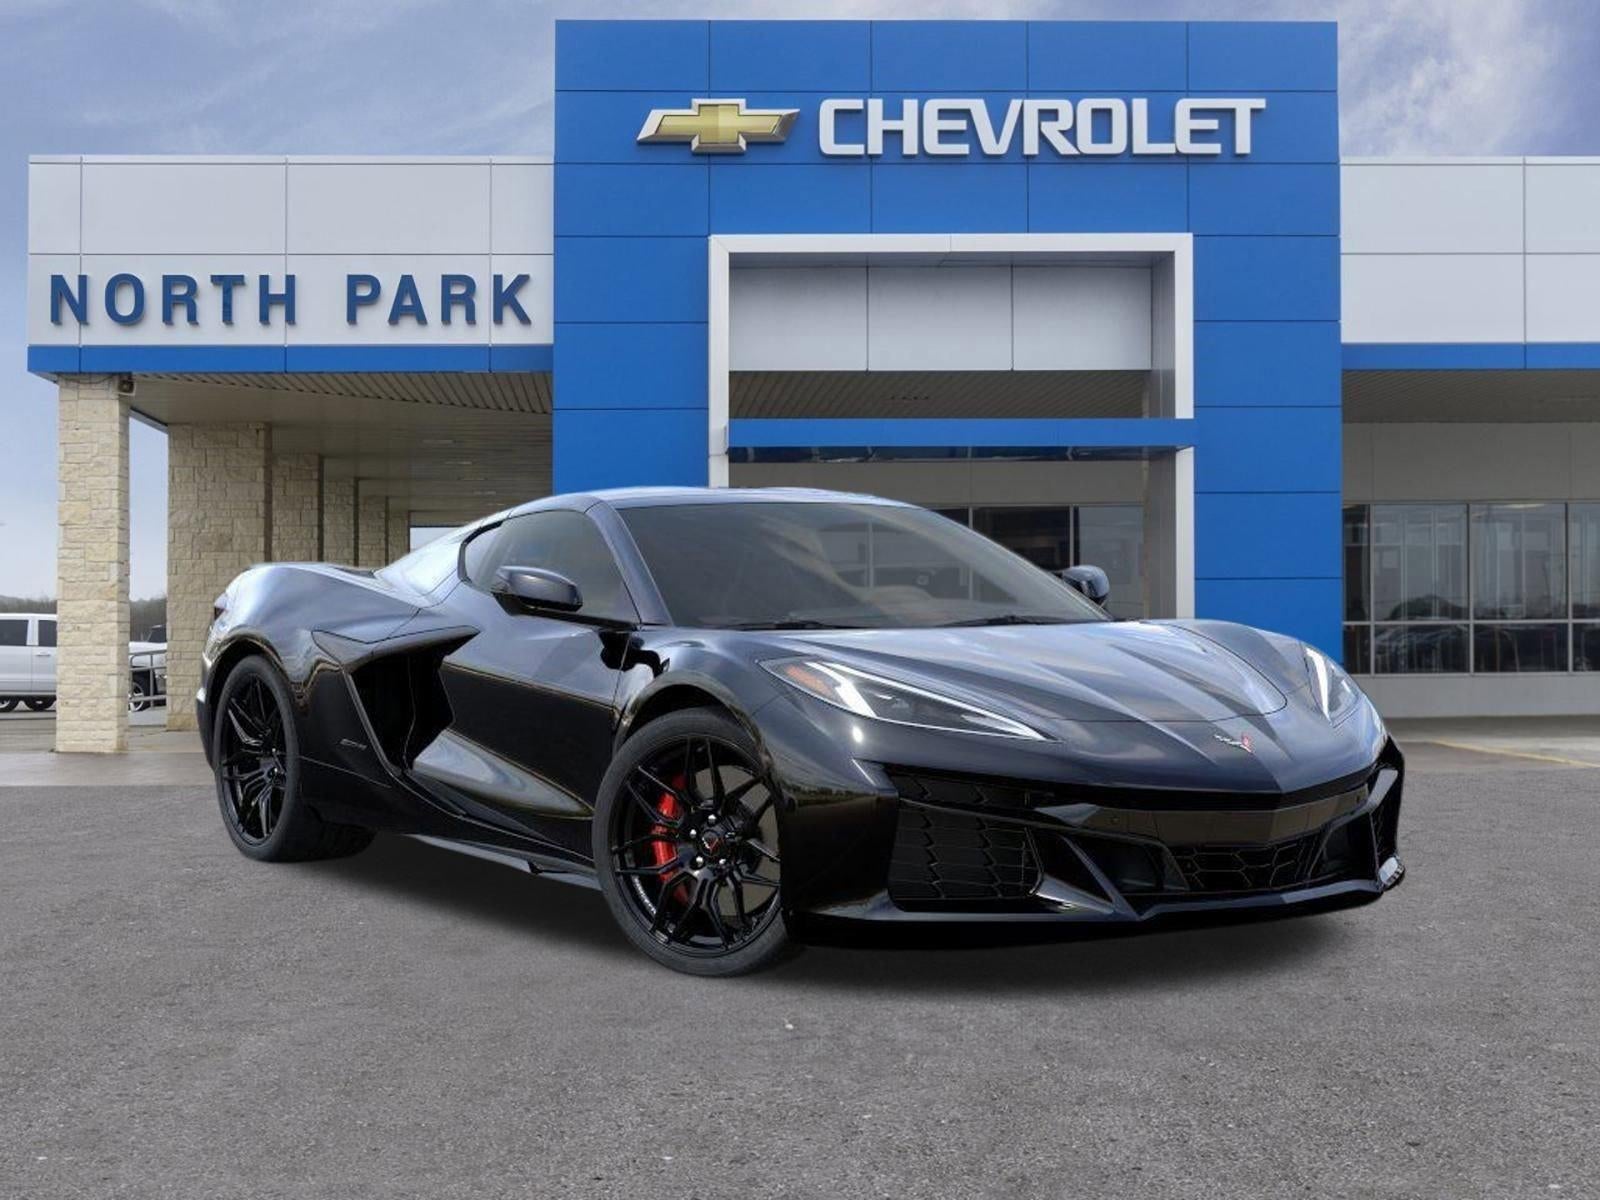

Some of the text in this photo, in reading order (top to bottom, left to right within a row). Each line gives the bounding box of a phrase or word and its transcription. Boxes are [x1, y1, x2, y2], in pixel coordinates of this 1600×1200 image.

[819, 98, 1267, 156] CHEVROLET
[50, 273, 533, 326] NORTH PARK
